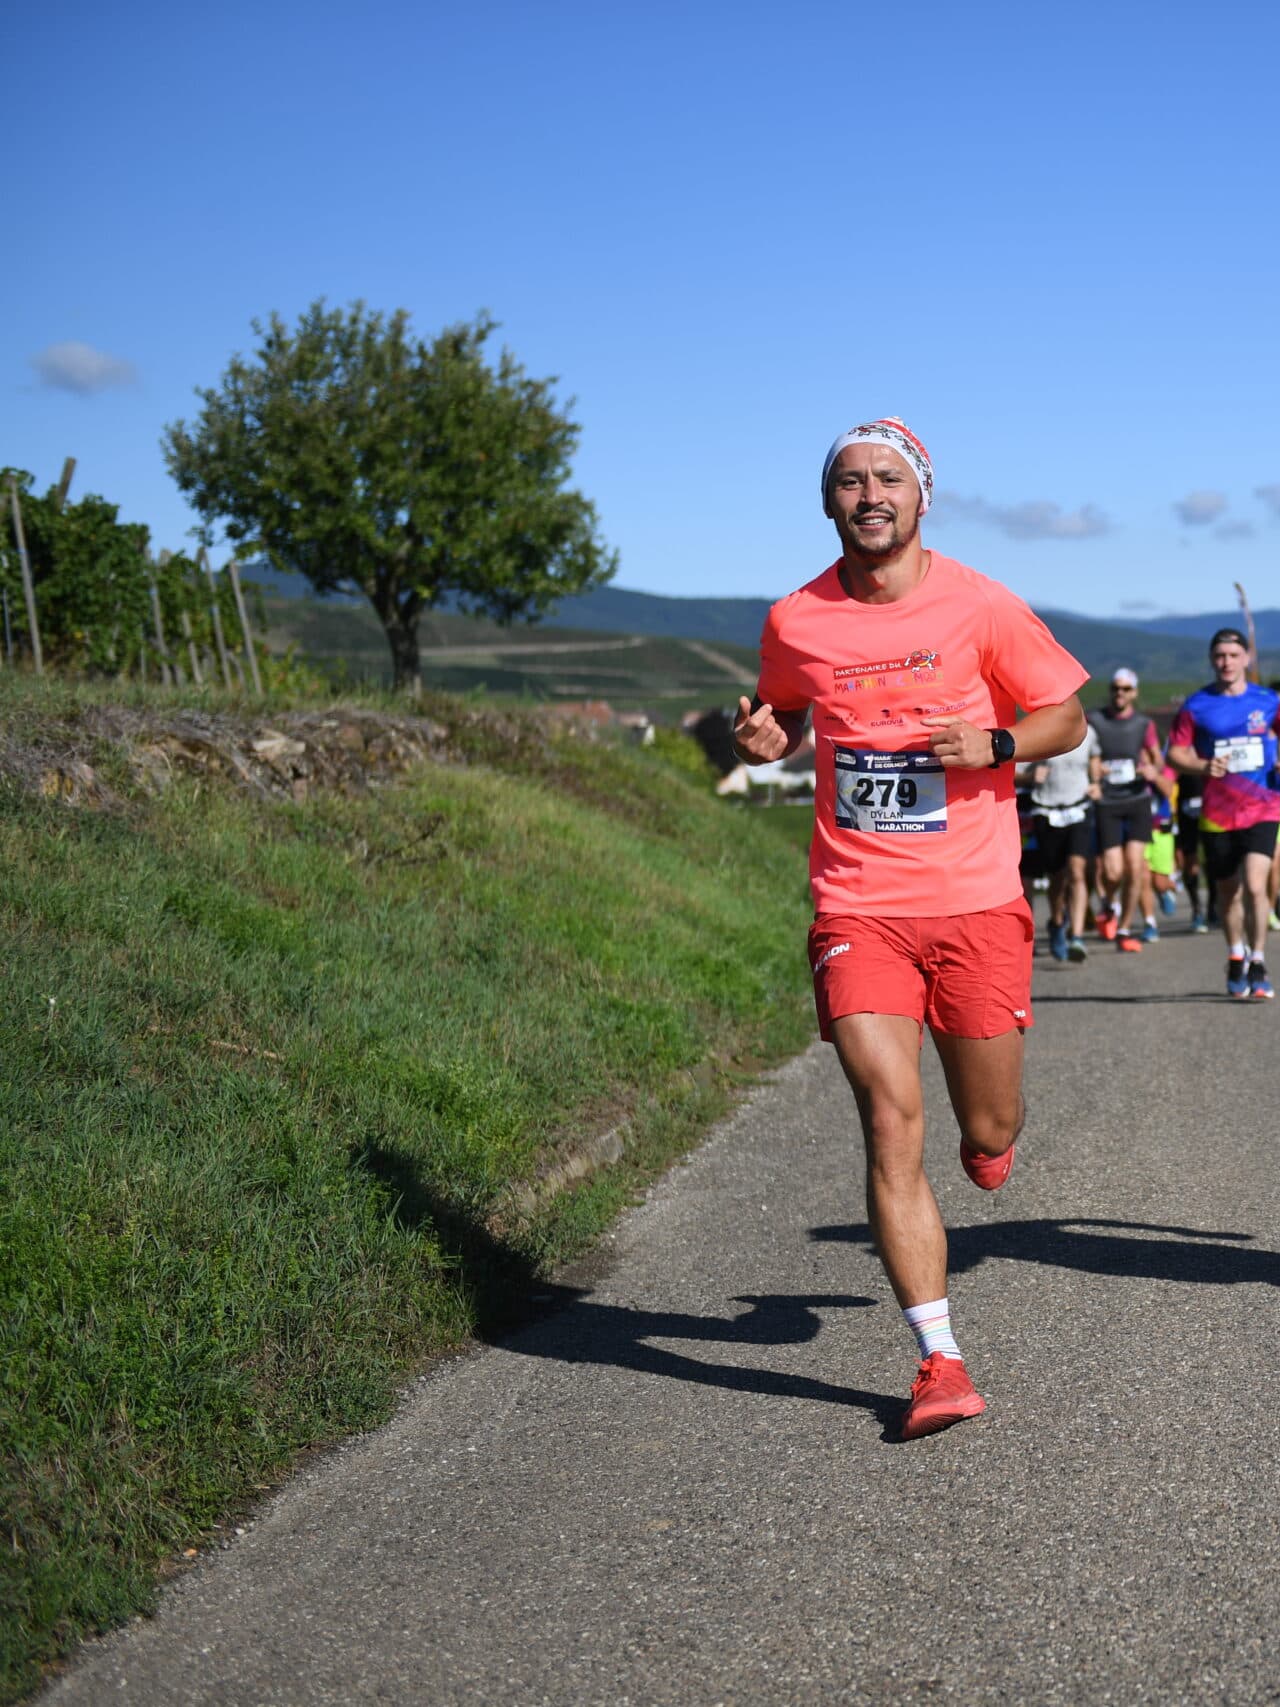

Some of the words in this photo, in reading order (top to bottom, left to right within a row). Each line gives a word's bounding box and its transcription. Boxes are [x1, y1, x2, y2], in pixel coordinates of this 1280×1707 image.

[835, 664, 887, 677] PARTENAIRE
[856, 778, 917, 808] 279
[870, 810, 904, 819] DYLAN
[876, 823, 925, 832] MARATHON
